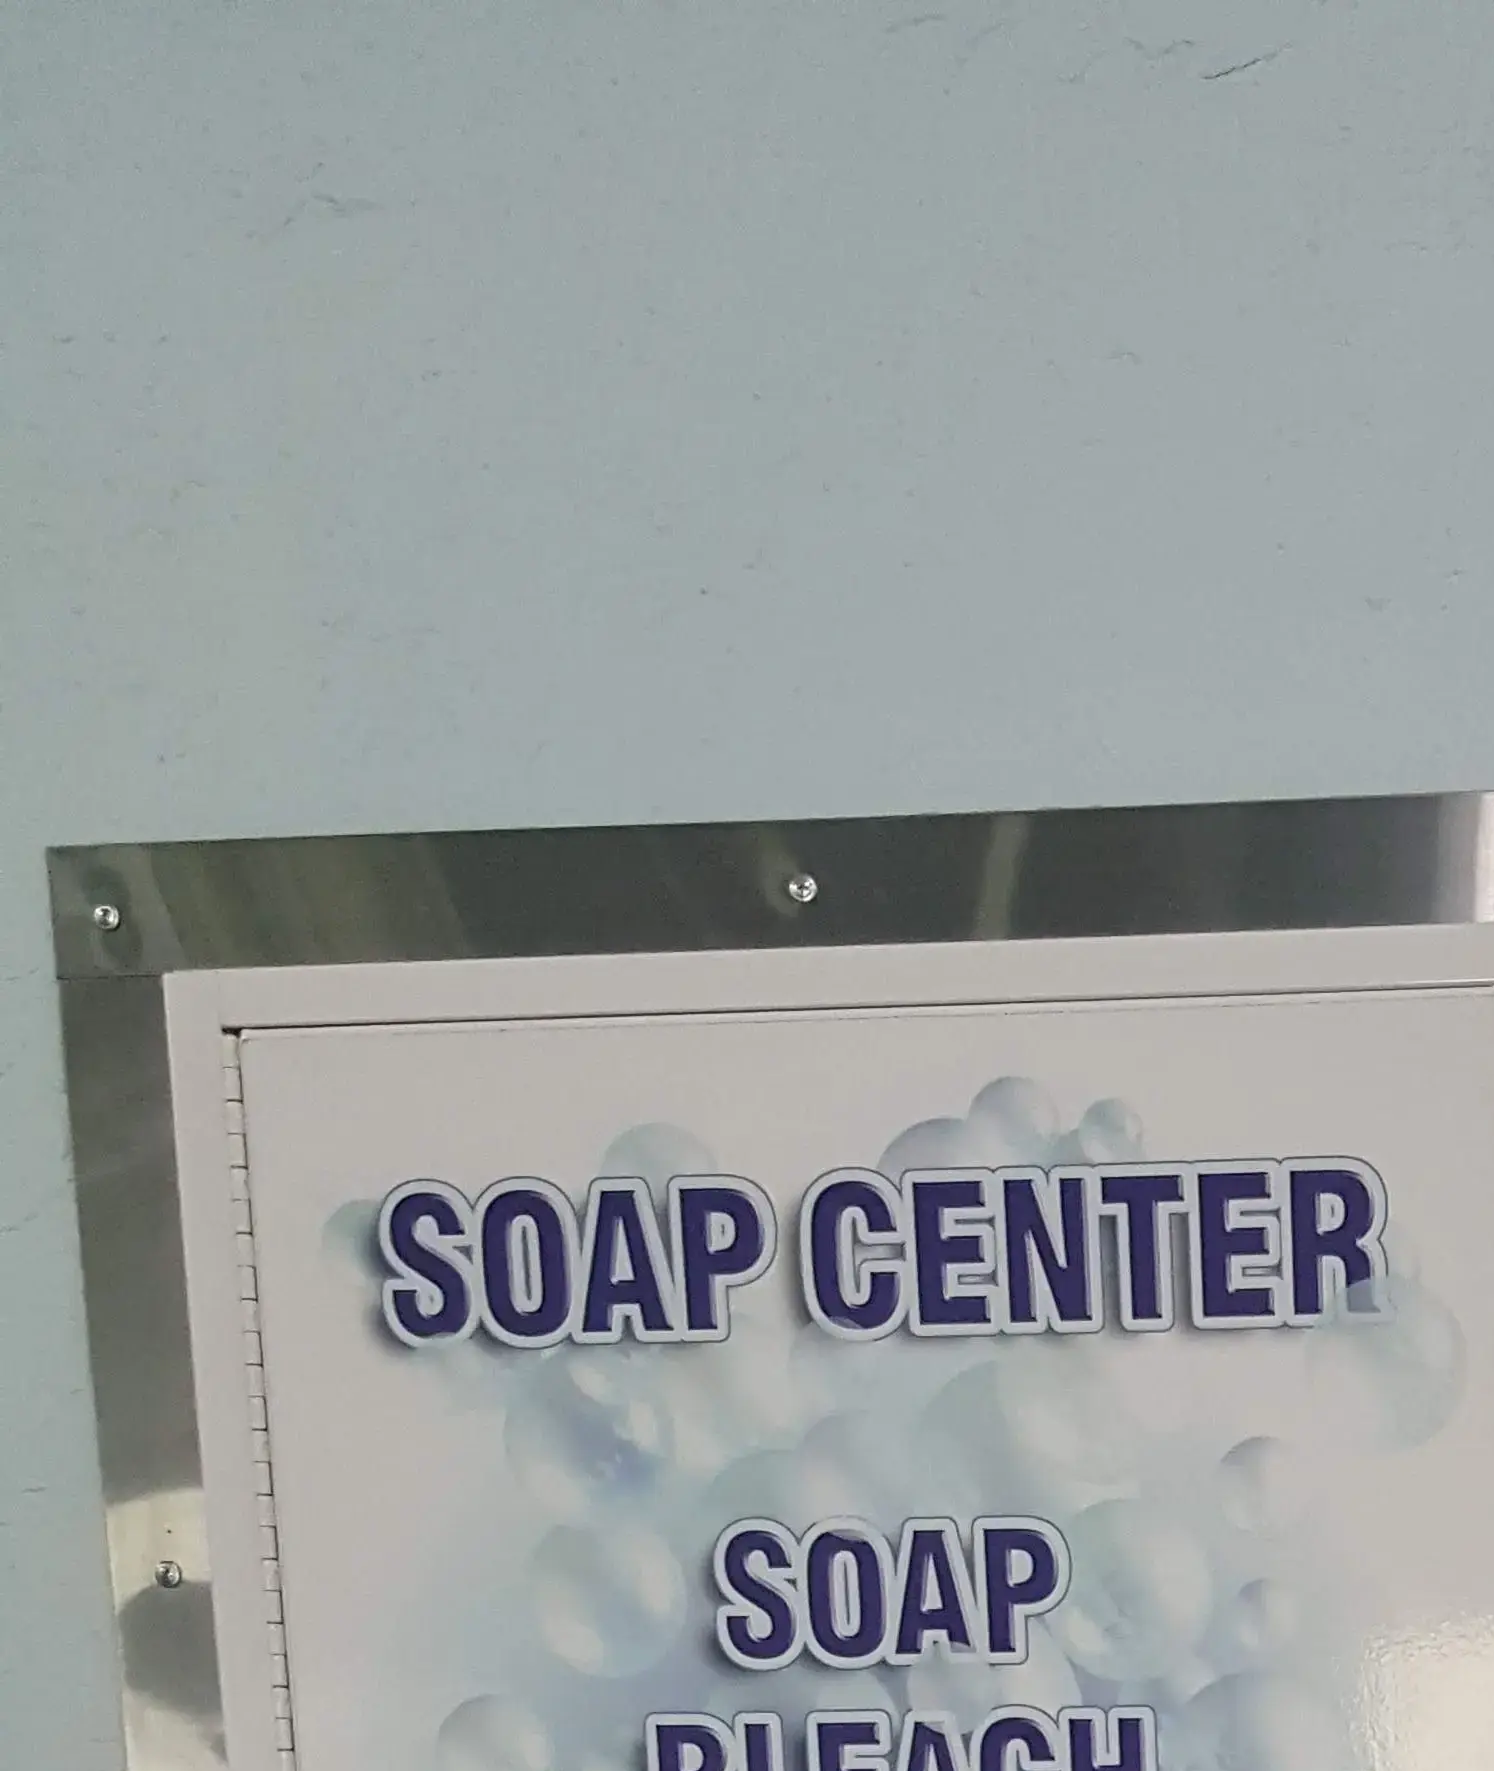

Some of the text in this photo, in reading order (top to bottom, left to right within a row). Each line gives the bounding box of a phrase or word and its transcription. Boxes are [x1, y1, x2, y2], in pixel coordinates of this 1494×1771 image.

[389, 1168, 1387, 1337] SOAP CENTER
[724, 1525, 1060, 1658] SOAP
